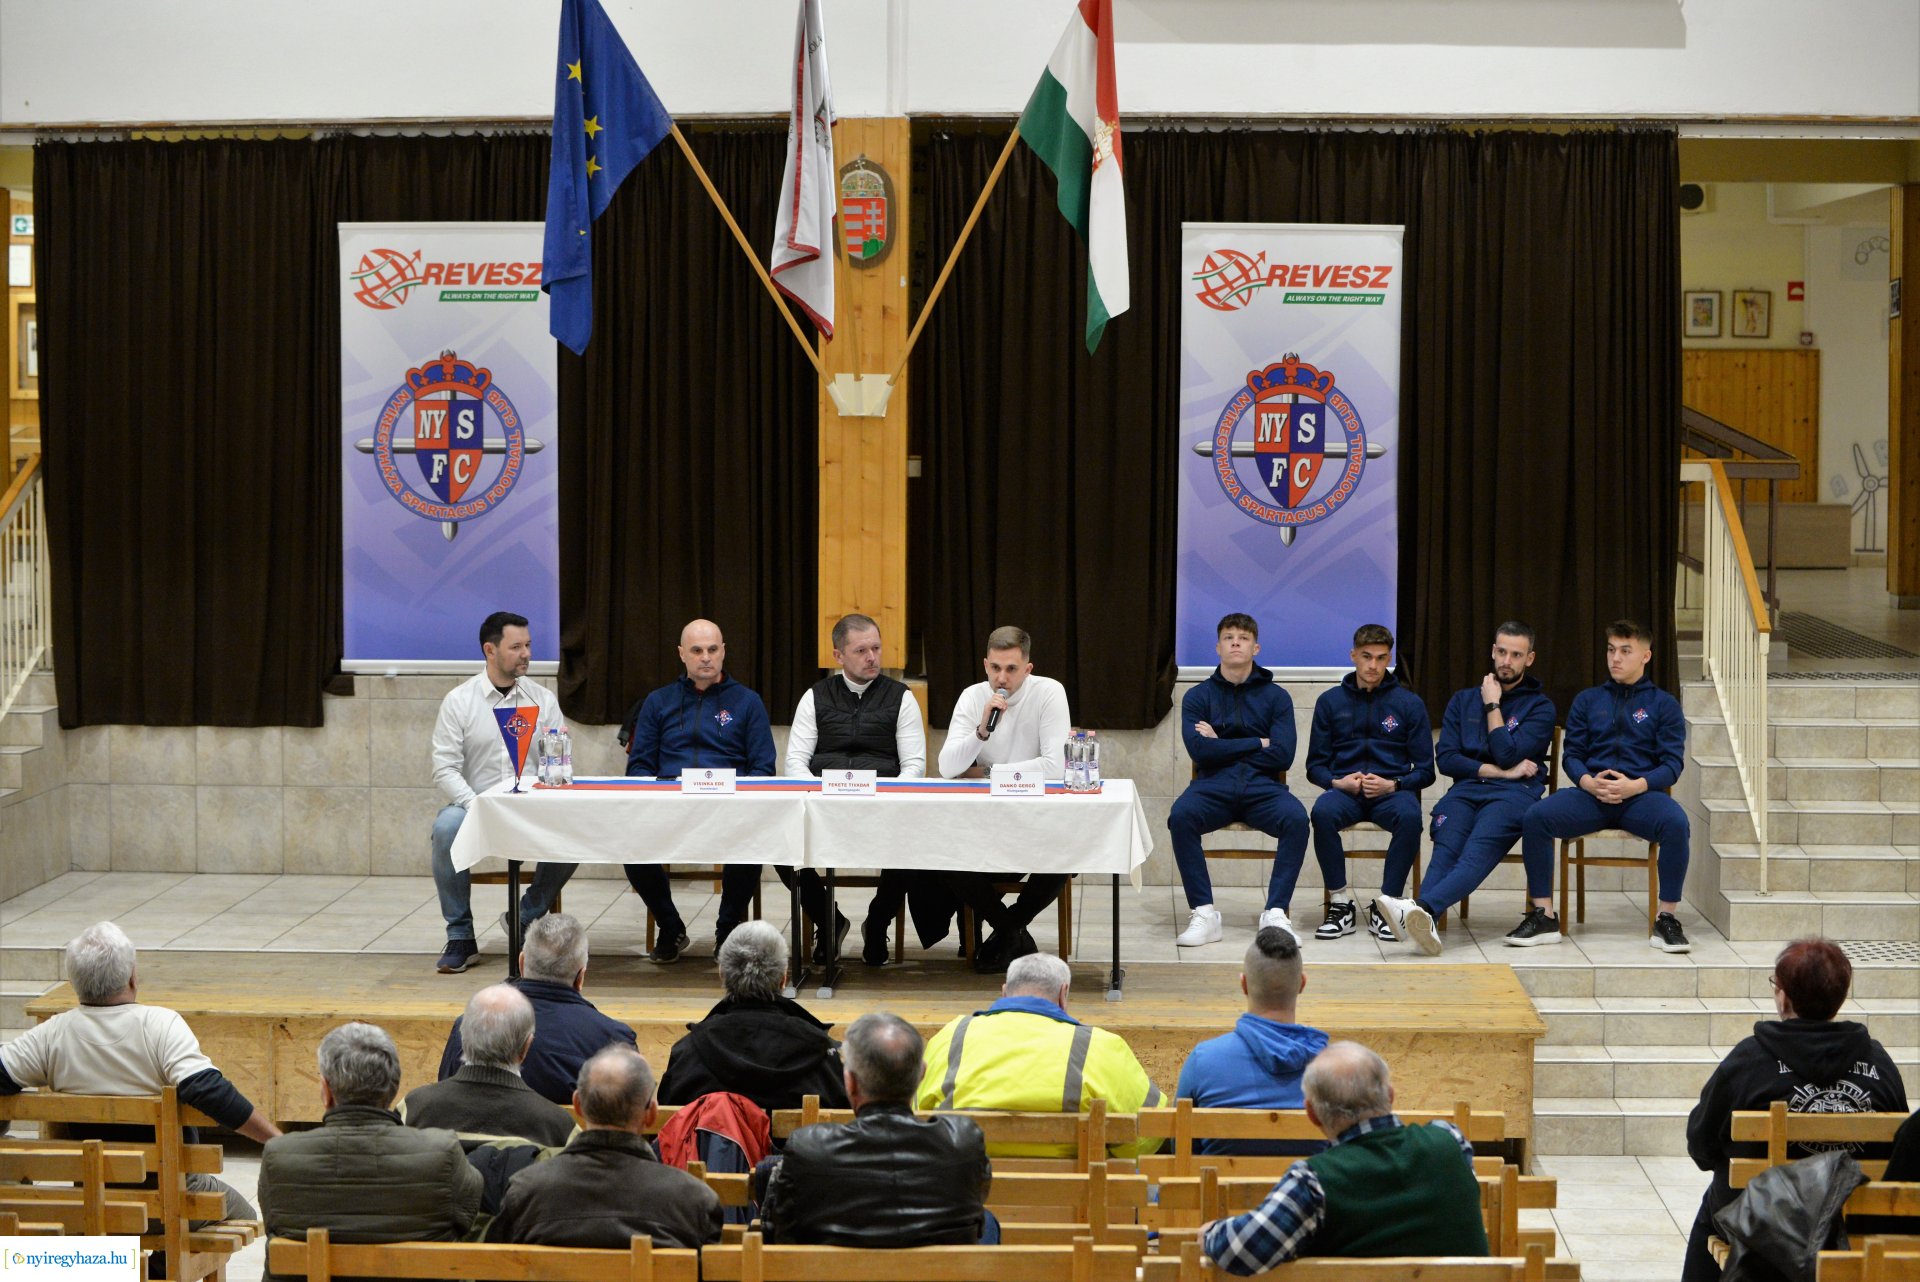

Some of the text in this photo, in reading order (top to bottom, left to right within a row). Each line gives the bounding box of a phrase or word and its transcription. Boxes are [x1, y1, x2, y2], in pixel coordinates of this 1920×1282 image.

[442, 292, 536, 300] ALWAYS ON THE RIGHT WAY
[1286, 294, 1316, 302] ALWAYS
[1316, 294, 1328, 302] ON
[1342, 295, 1364, 303] RIGHT
[1364, 295, 1382, 303] WAY
[417, 409, 447, 439] NY
[487, 391, 518, 427] CLUB
[1257, 412, 1288, 443] NY
[488, 428, 522, 505] FOOTBALL
[1215, 392, 1363, 523] NYÍREGYHÁZA SPARTACUS FOOTBALL CLUB
[401, 491, 487, 519] SPARTACUS
